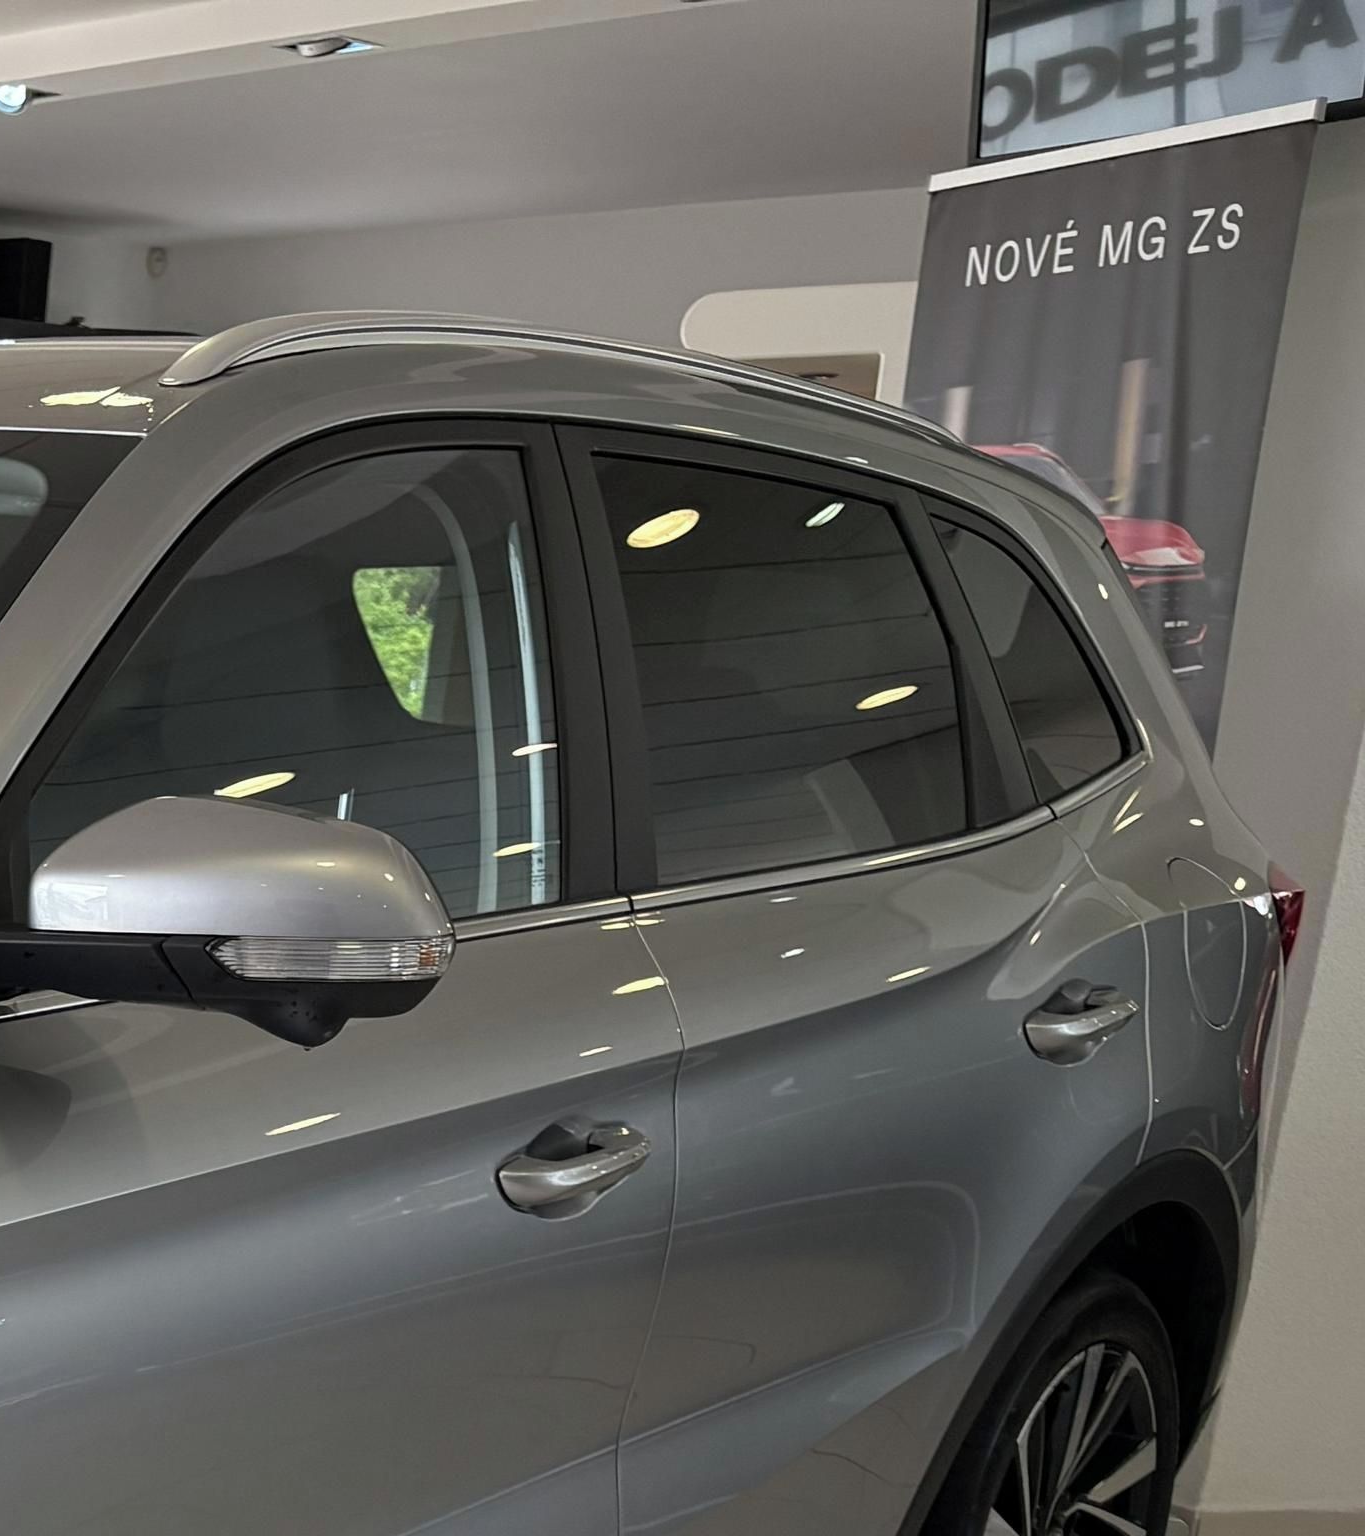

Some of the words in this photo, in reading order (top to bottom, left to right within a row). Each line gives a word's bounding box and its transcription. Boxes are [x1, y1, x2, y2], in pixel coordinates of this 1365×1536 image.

[965, 220, 1079, 287] NOVÉ
[1098, 215, 1167, 267] MG
[1187, 203, 1244, 254] ZS
